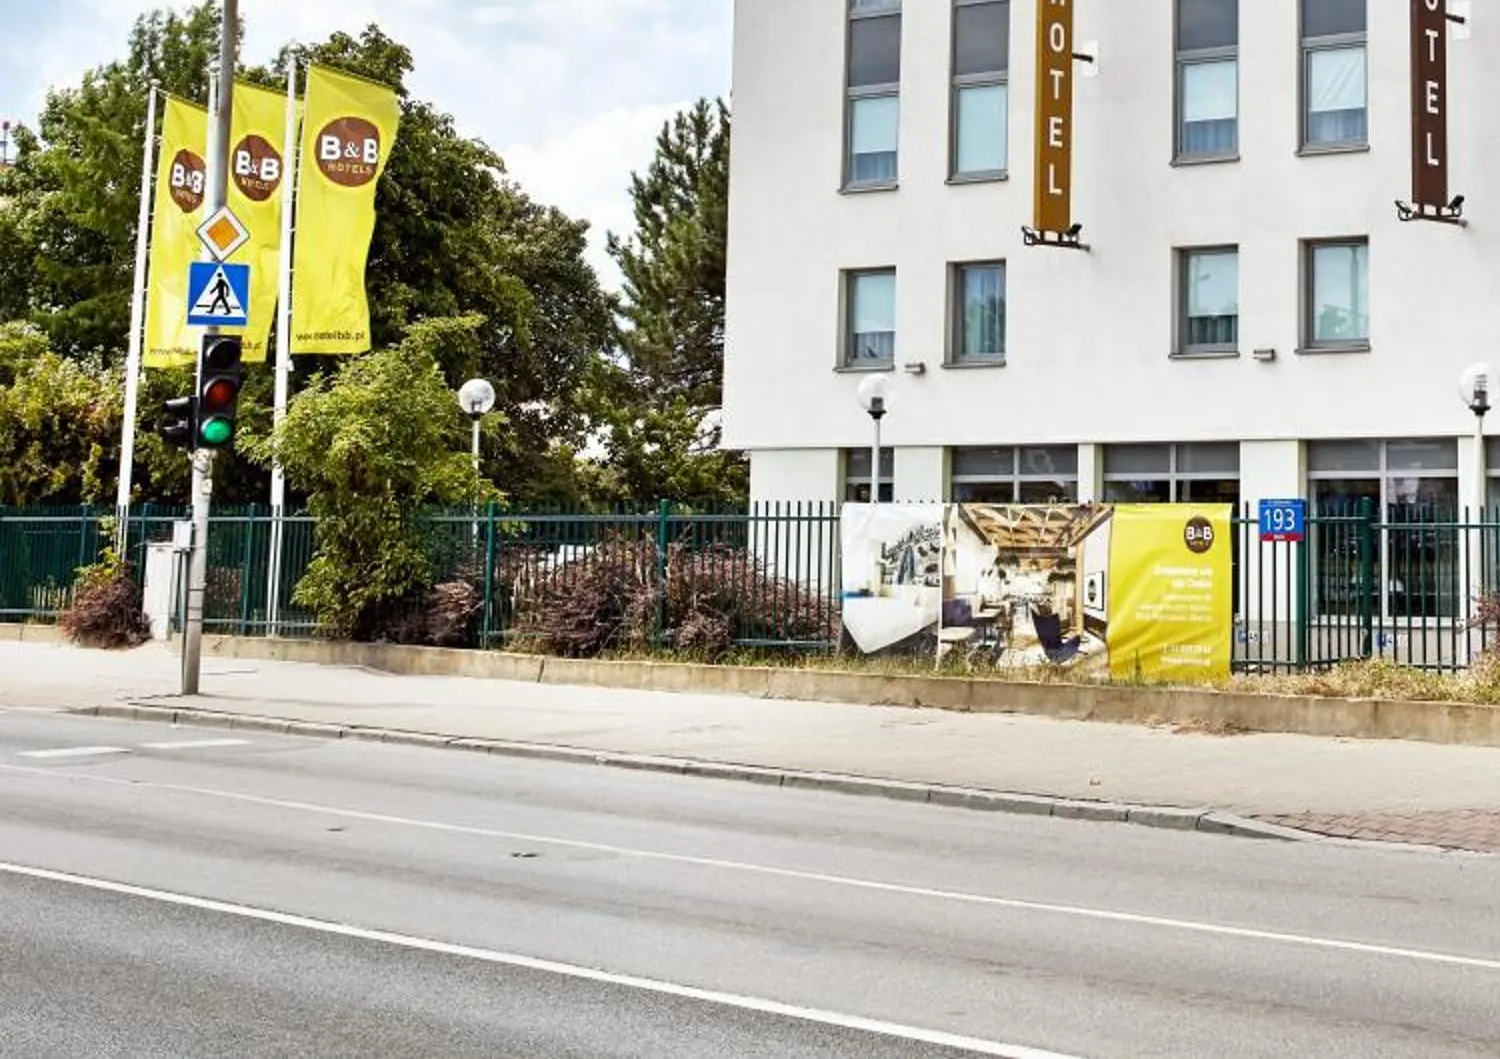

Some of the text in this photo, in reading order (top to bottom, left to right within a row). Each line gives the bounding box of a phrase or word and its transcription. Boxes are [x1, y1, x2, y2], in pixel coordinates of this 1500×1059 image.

[320, 134, 378, 164] B&B
[171, 162, 205, 195] B&B
[235, 149, 280, 181] B&B
[327, 161, 374, 176] HOTELS
[1264, 508, 1296, 531] 193
